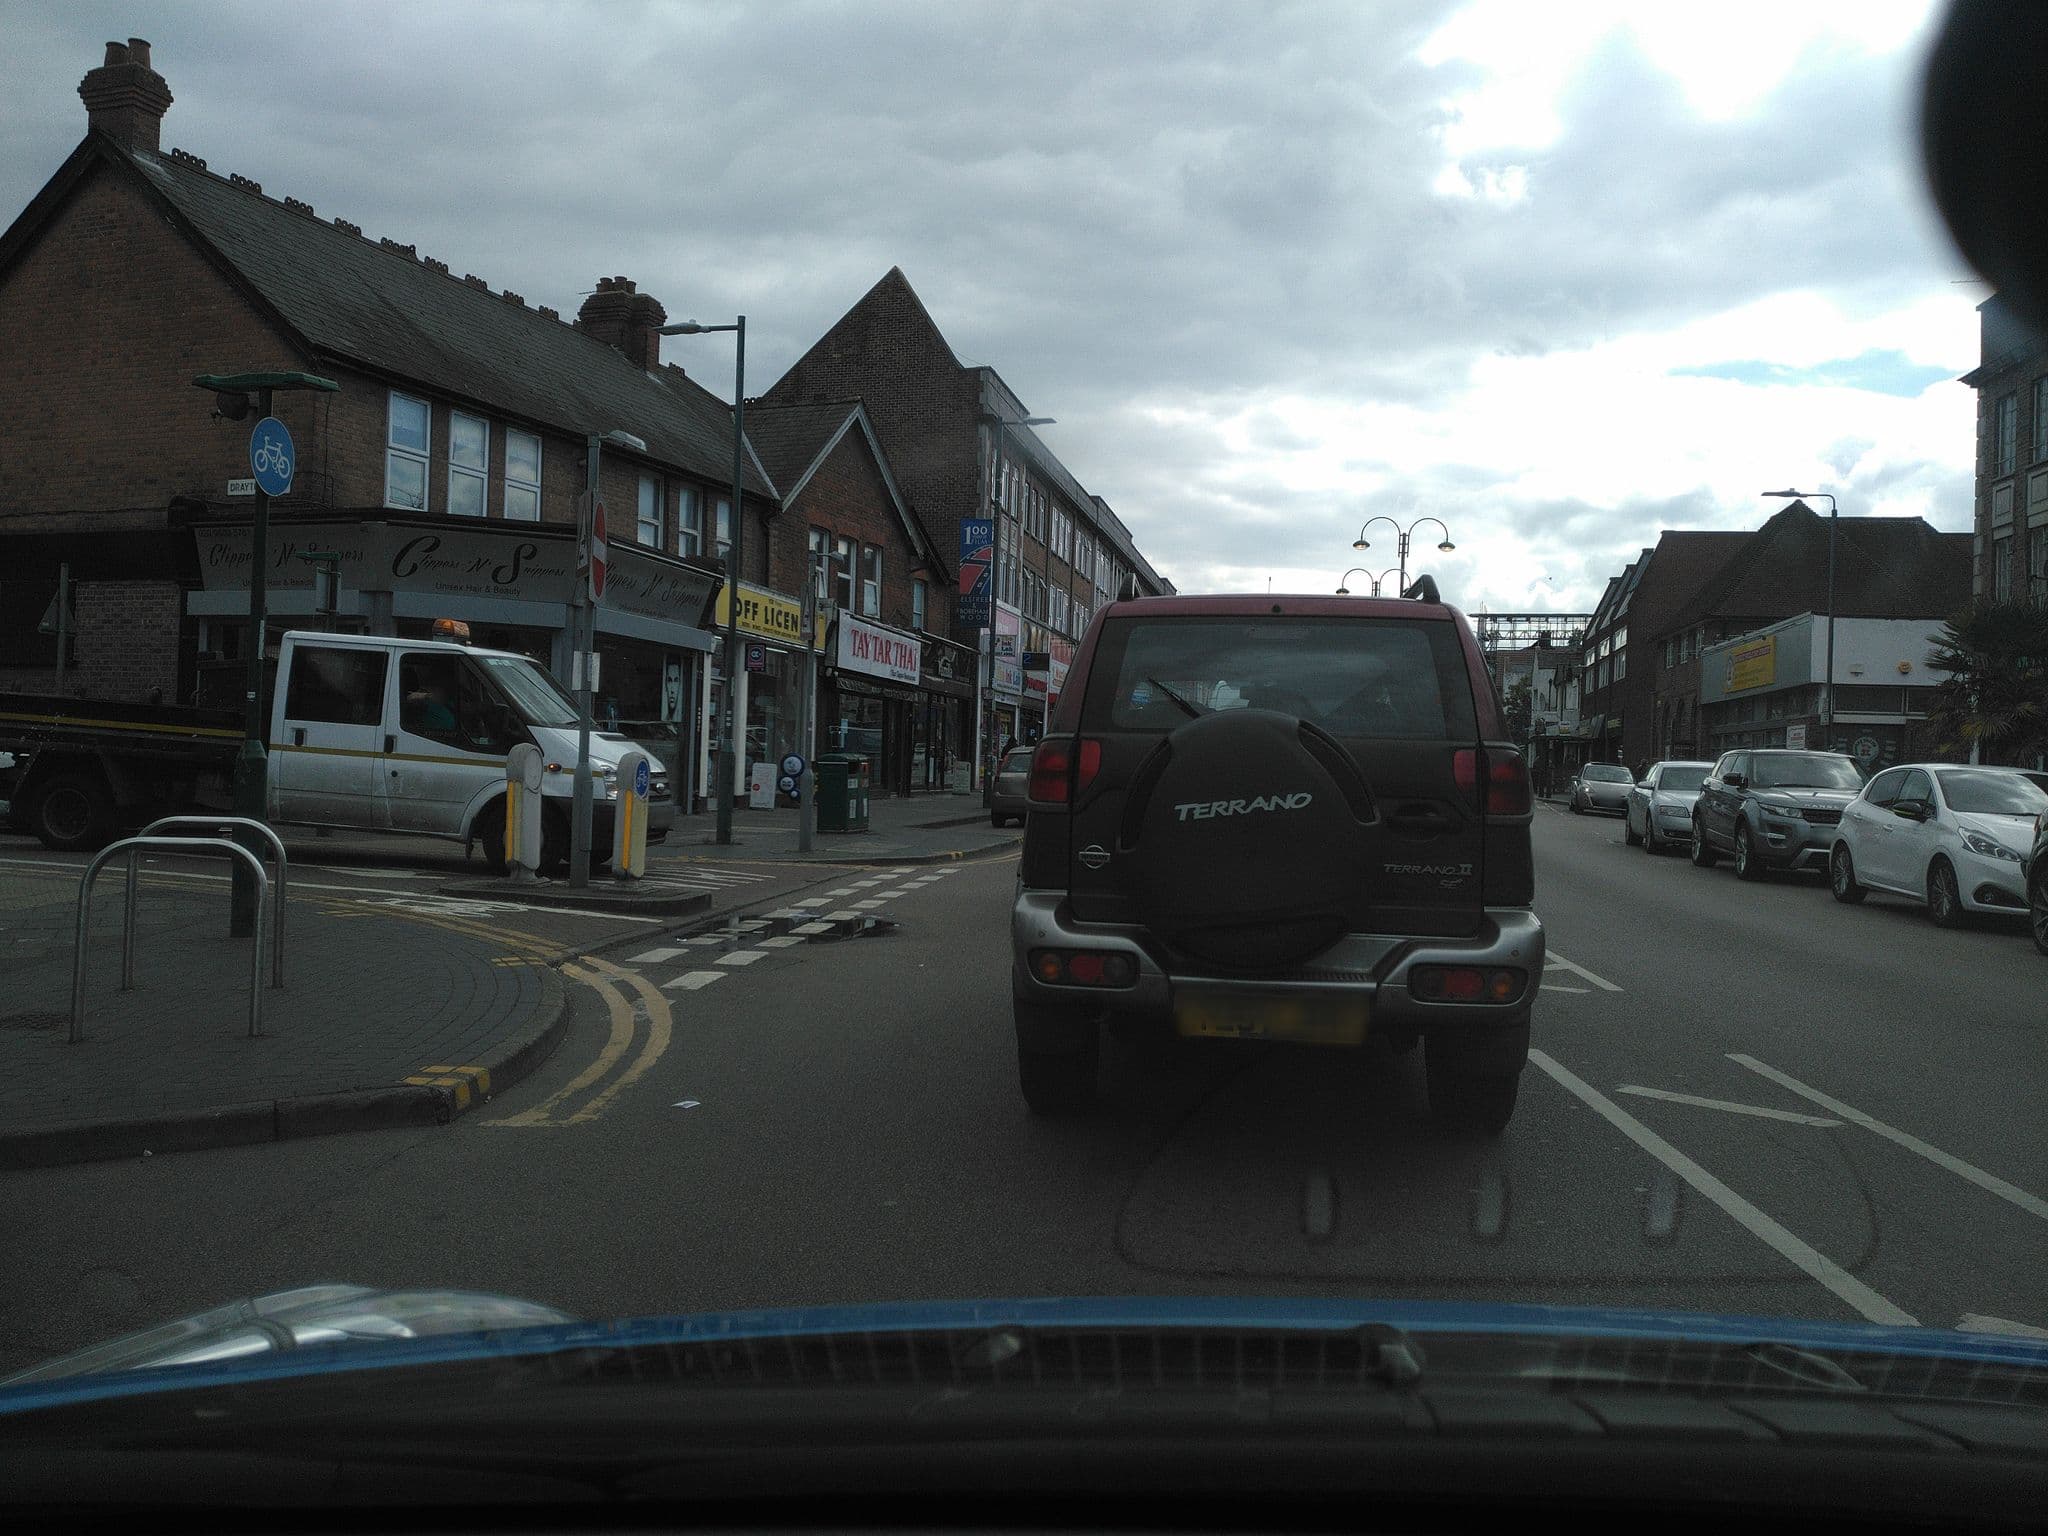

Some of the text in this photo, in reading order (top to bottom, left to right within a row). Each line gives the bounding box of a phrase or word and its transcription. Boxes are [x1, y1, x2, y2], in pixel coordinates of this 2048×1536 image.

[964, 526, 988, 545] 100
[466, 584, 482, 593] Hair
[764, 606, 799, 633] LICEN
[850, 629, 918, 672] TAY TAR THAI
[1174, 792, 1313, 822] TERRANO
[1383, 864, 1473, 876] TERRANO II
